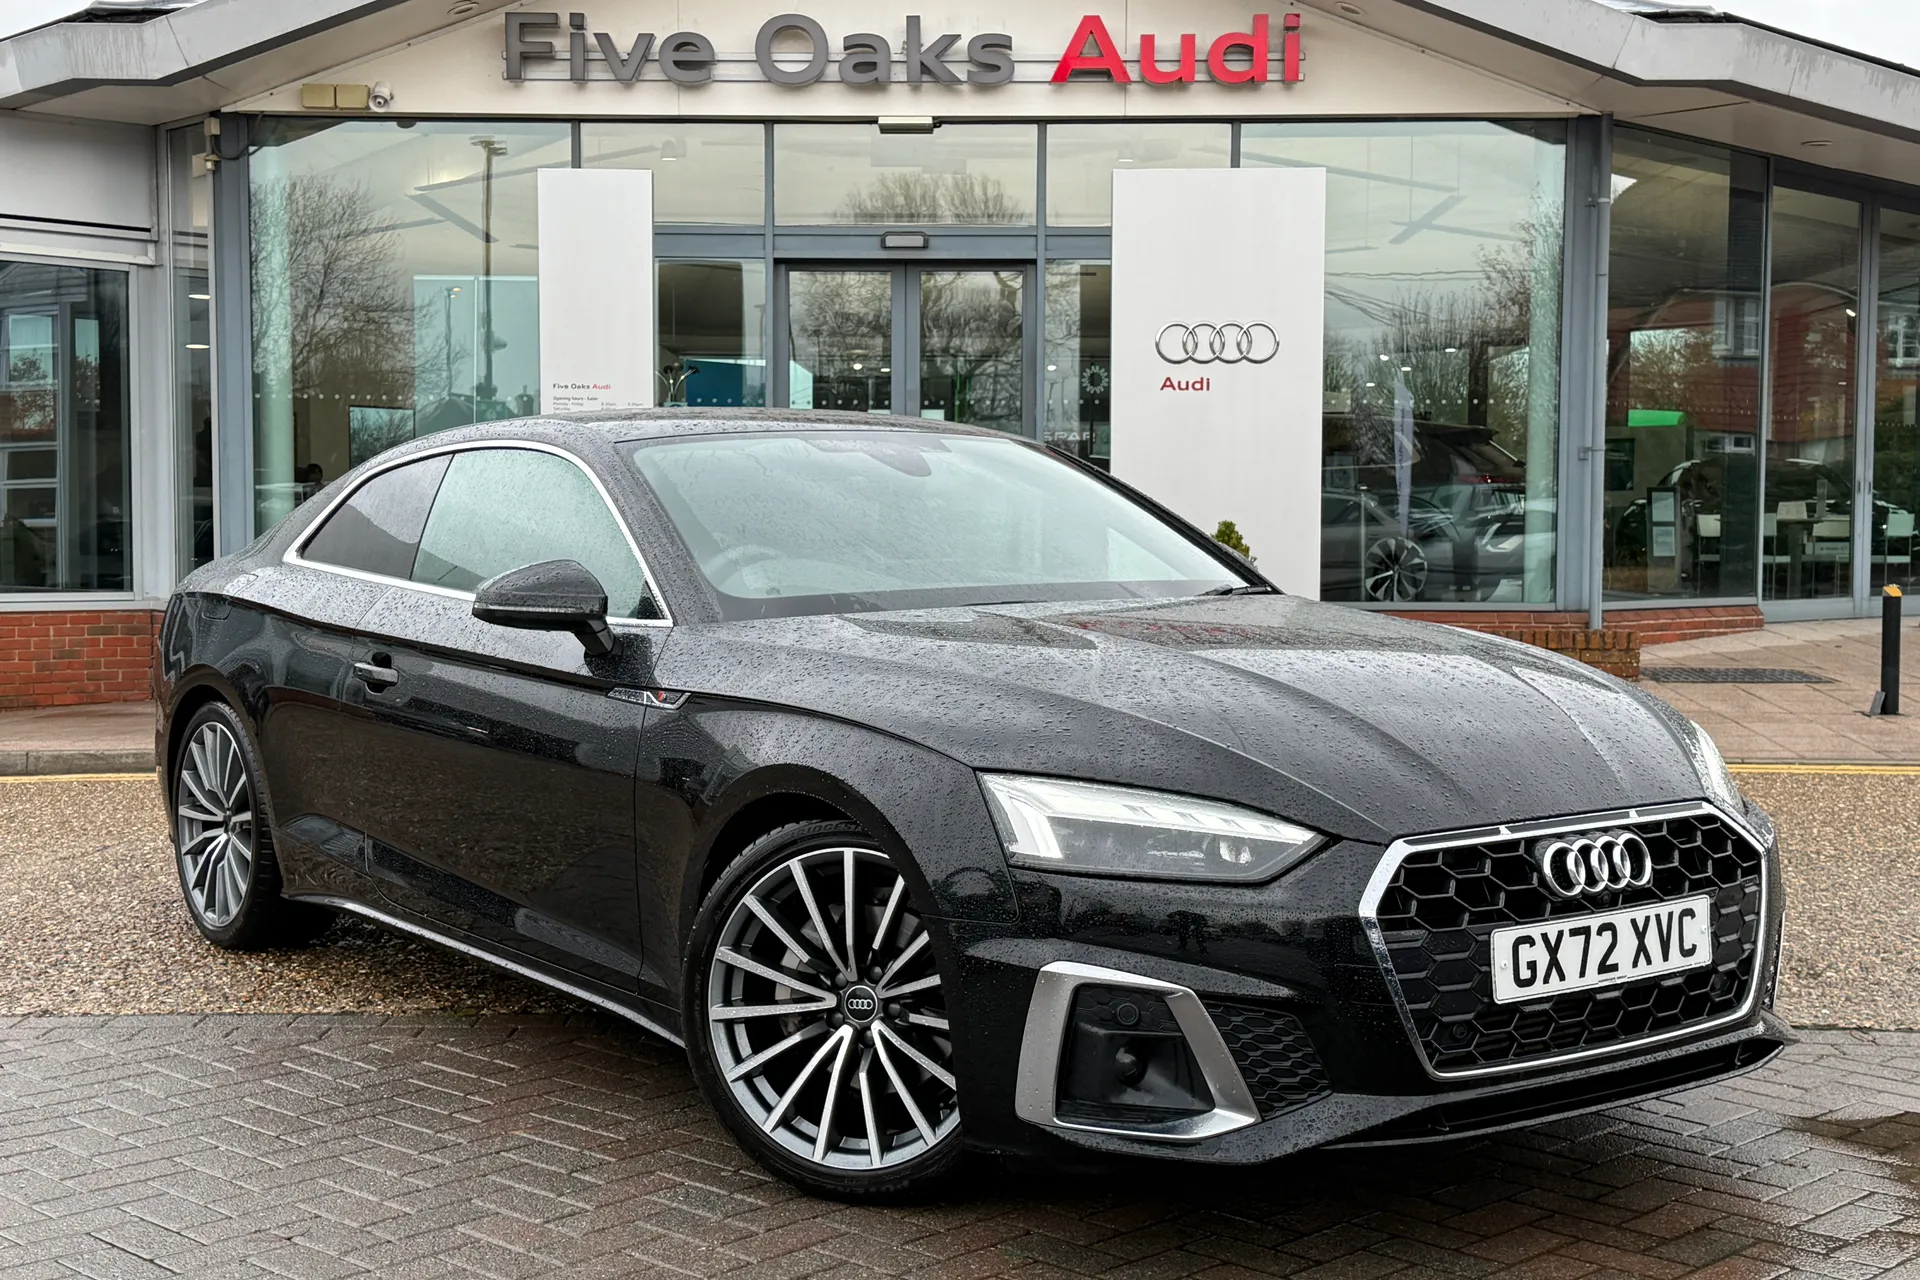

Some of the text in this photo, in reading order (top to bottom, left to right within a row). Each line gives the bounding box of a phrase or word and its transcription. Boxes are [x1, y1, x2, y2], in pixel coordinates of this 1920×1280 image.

[504, 12, 1301, 87] Five Oaks Audi
[1160, 376, 1210, 391] Audi
[1511, 908, 1698, 988] GX72 XVC
